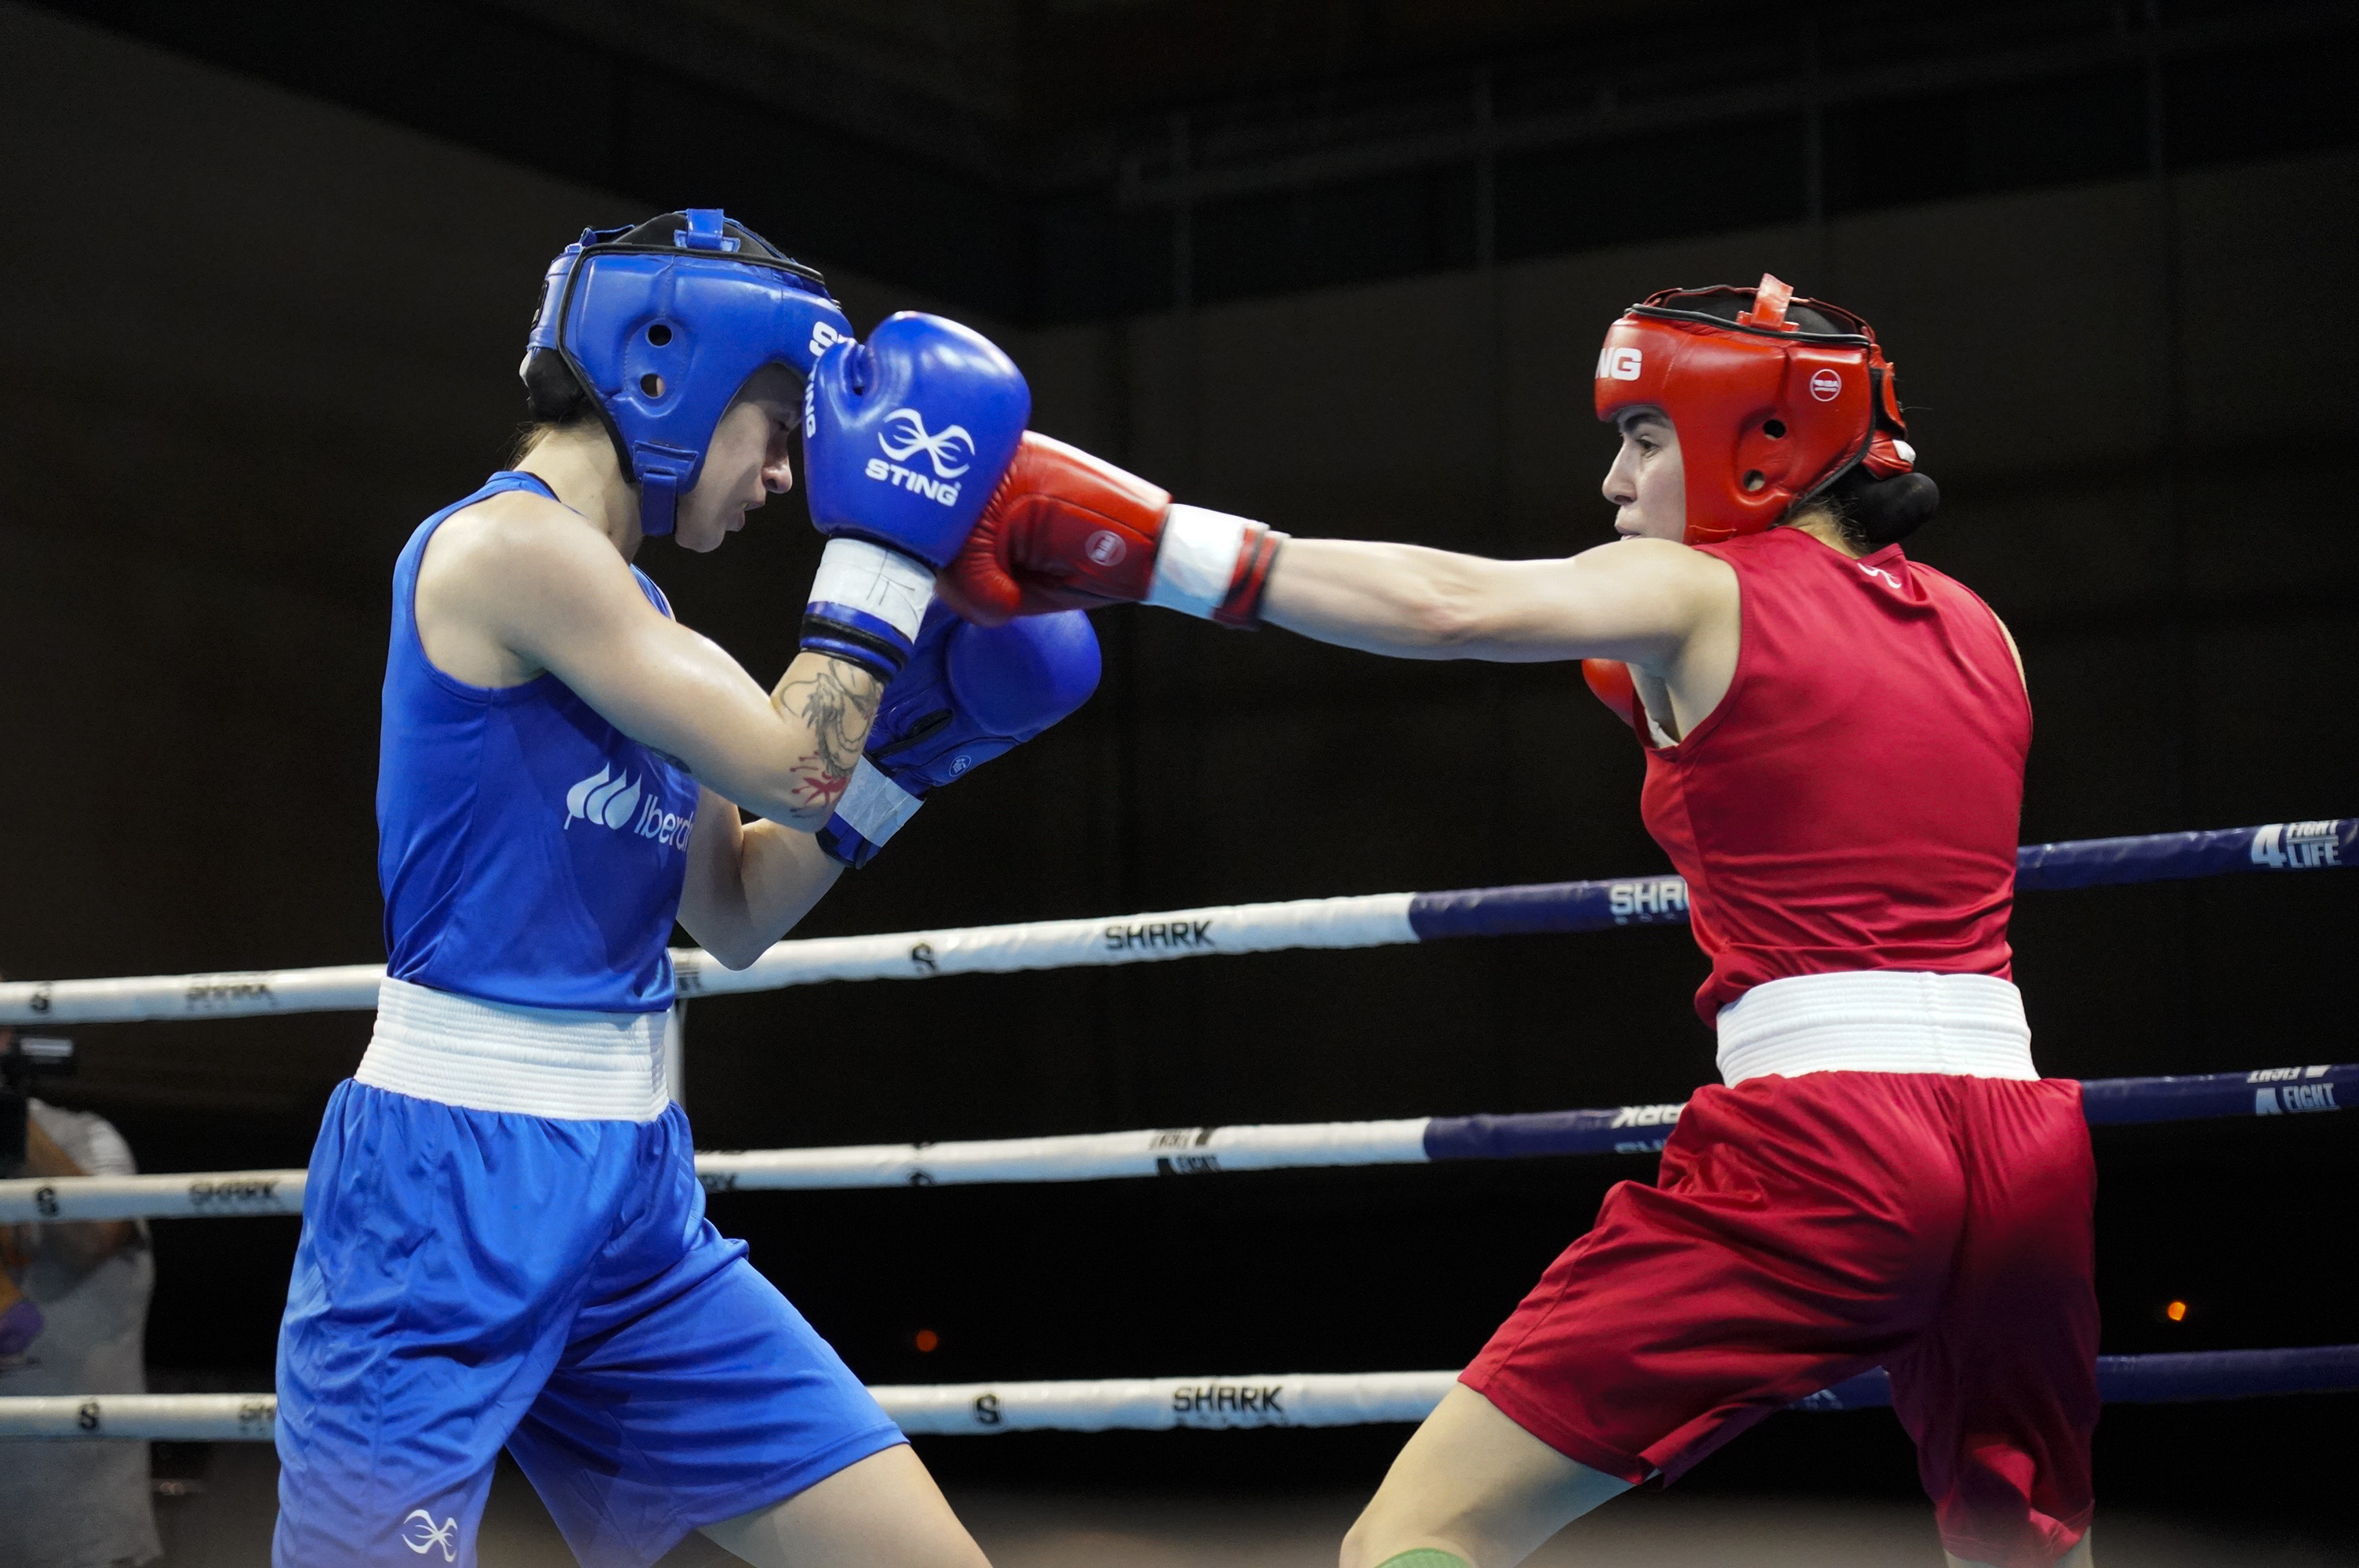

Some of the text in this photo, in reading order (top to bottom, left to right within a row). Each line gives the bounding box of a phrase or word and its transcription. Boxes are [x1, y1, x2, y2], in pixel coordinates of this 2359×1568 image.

[865, 458, 959, 506] STING
[2251, 823, 2288, 869] 4
[2286, 840, 2343, 869] LIFE
[1106, 920, 1215, 950] SHARK
[2283, 1083, 2336, 1110] FIGHT
[976, 1394, 1000, 1425] S
[1173, 1385, 1285, 1413] SHARK
